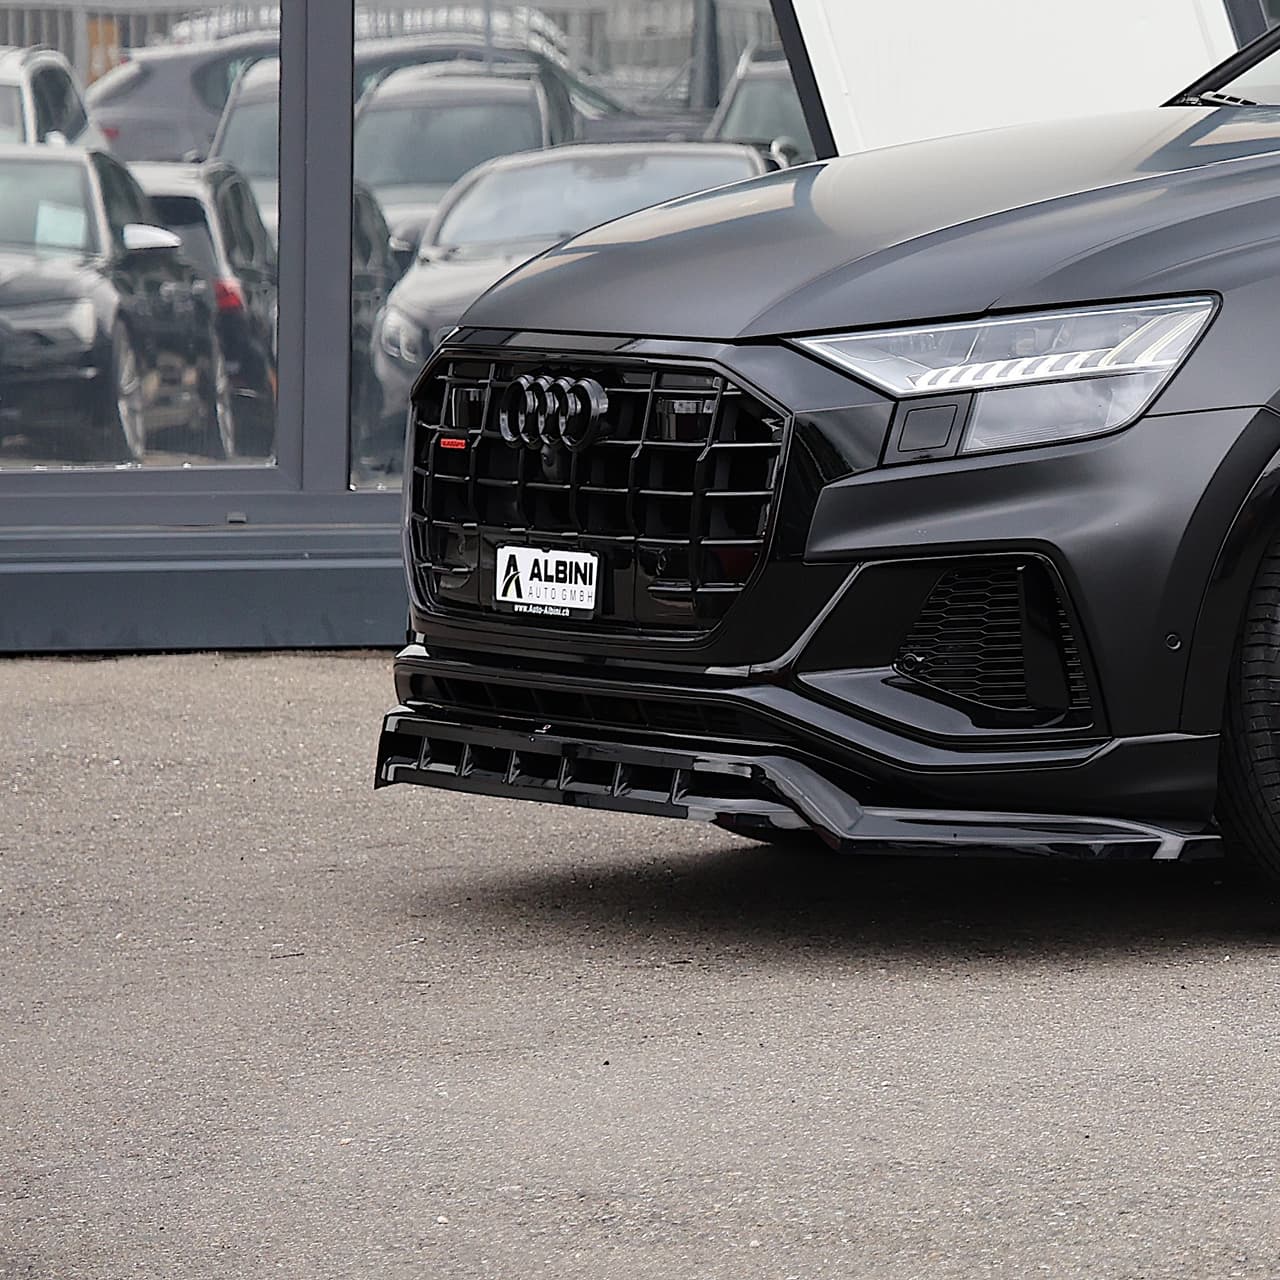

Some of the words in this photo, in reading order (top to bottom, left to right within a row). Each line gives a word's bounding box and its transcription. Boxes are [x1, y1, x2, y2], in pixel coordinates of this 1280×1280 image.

[529, 558, 593, 585] ALBINI
[528, 586, 557, 600] AUTO
[561, 588, 594, 603] GMBH
